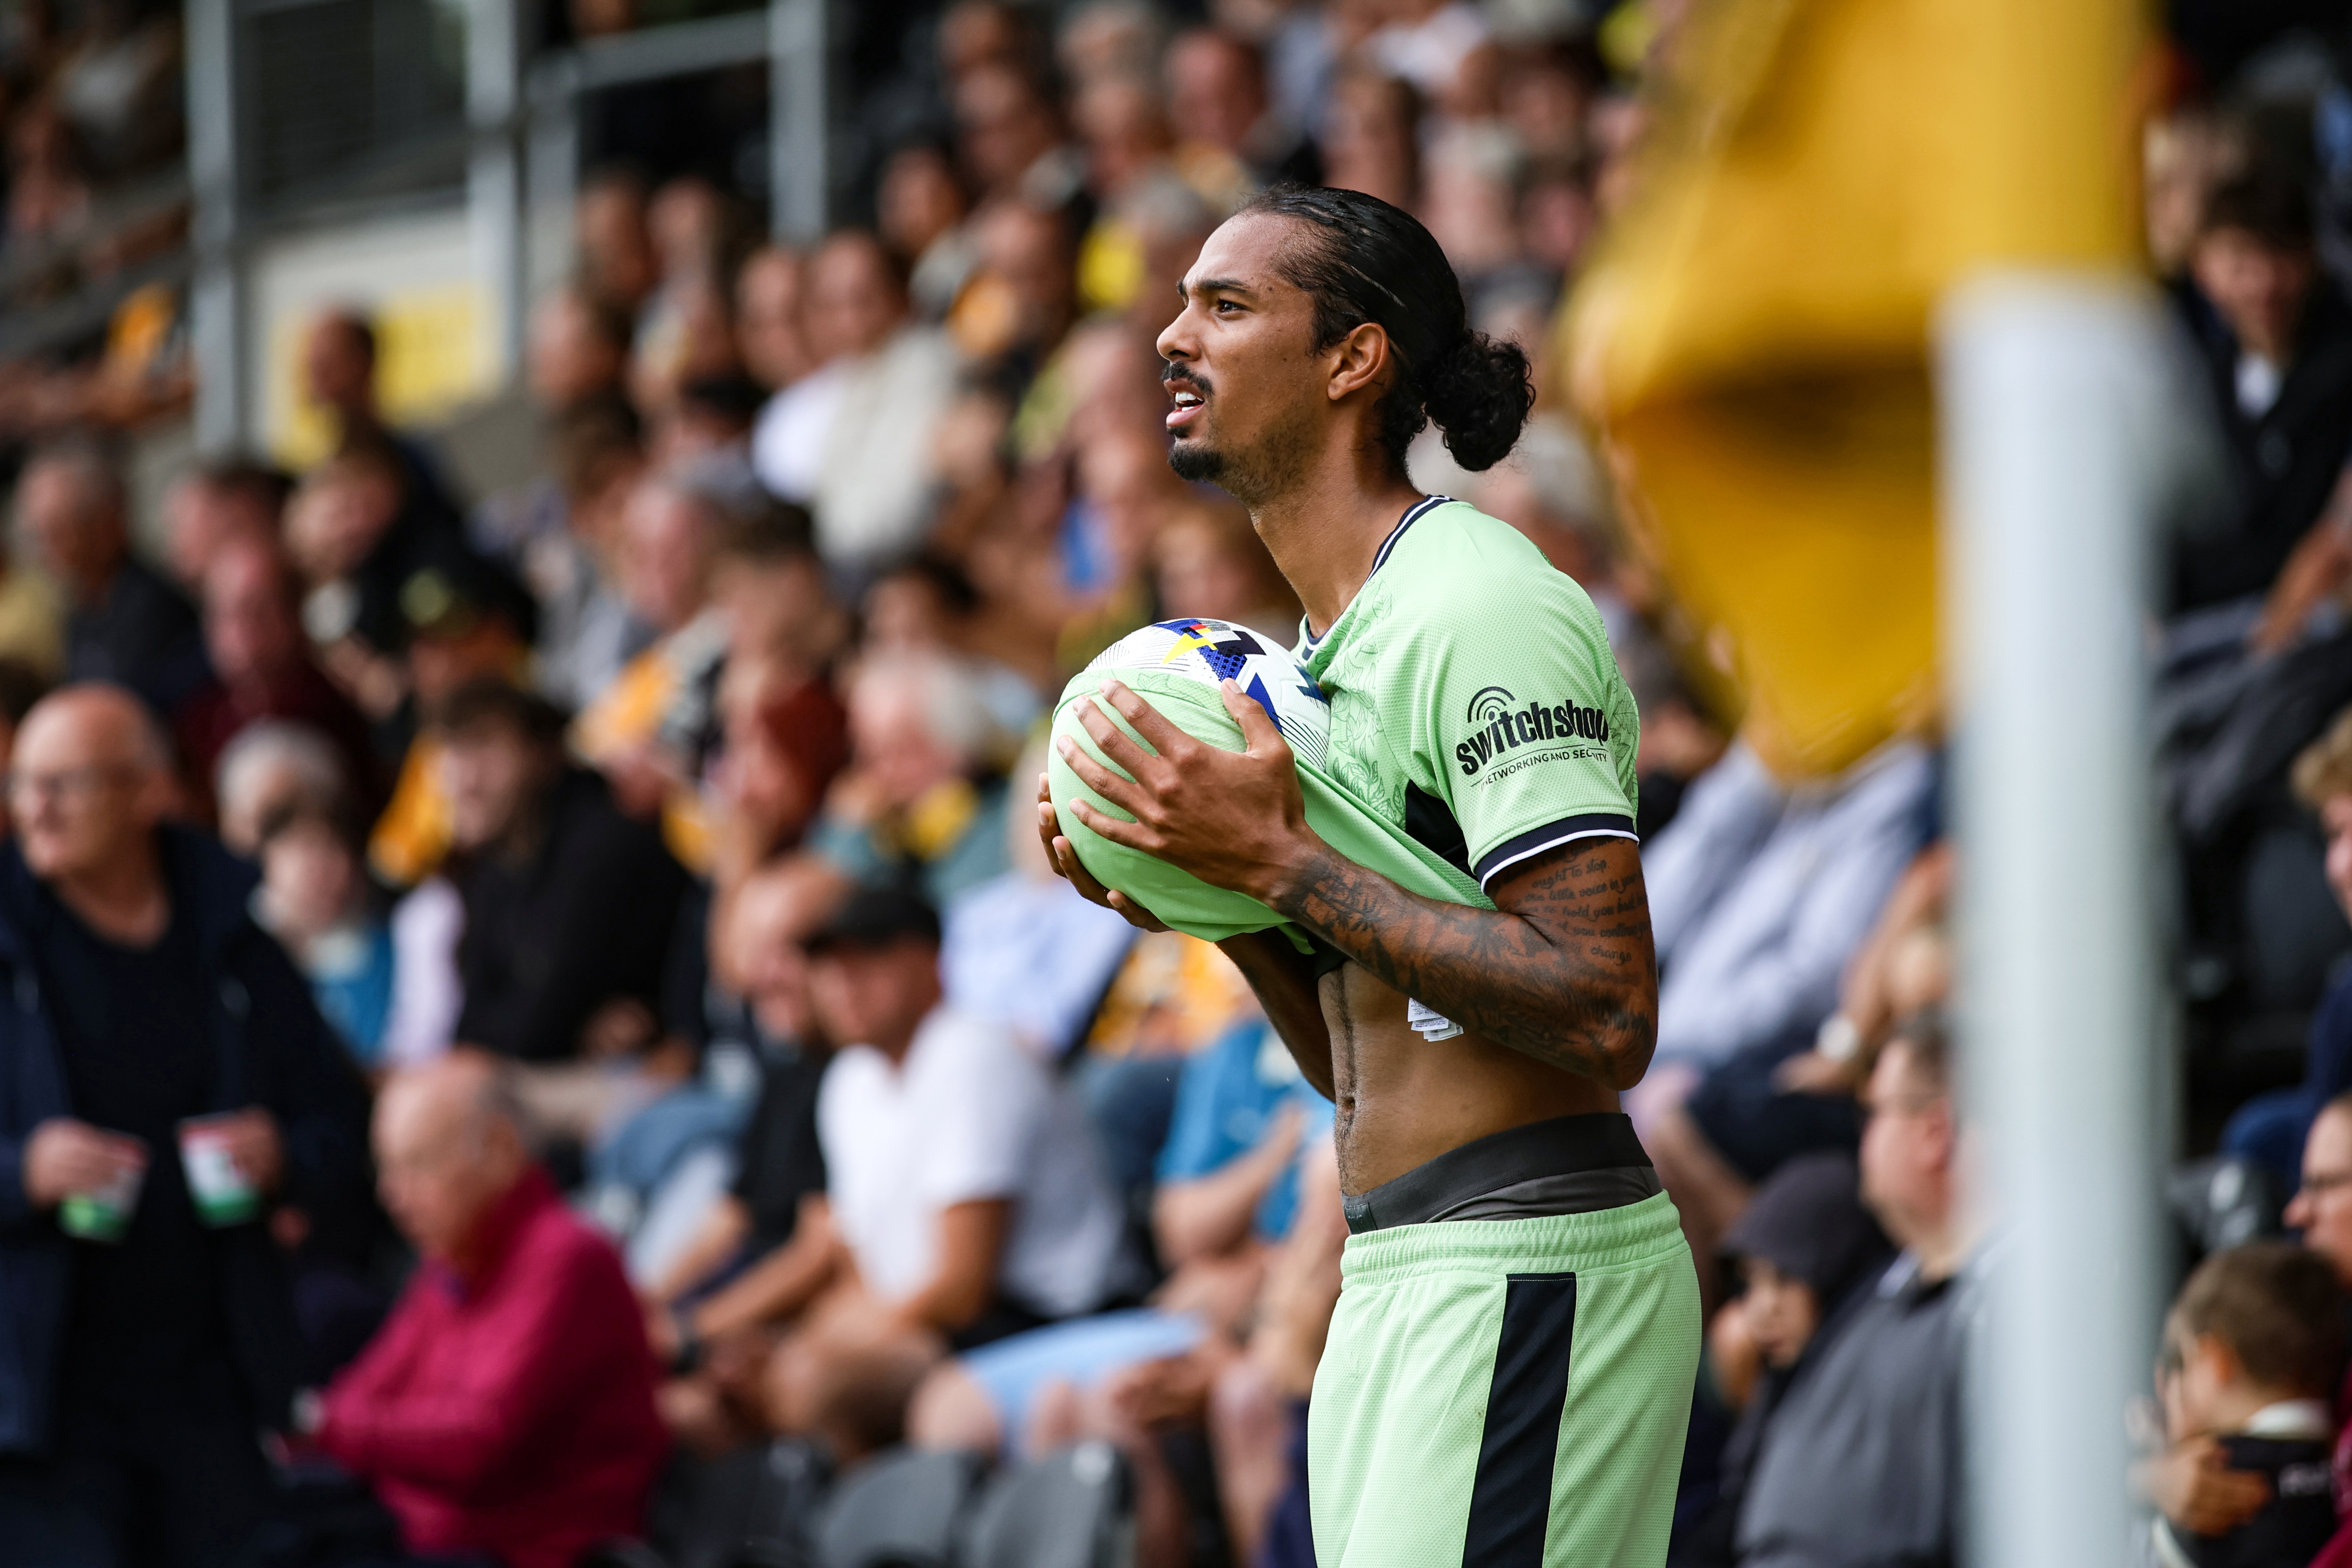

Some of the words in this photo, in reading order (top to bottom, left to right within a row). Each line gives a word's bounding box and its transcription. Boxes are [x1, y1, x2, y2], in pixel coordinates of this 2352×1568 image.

[1456, 699, 1609, 775] switchshop
[1485, 754, 1549, 786] NETWORKING
[1551, 752, 1569, 760] AND
